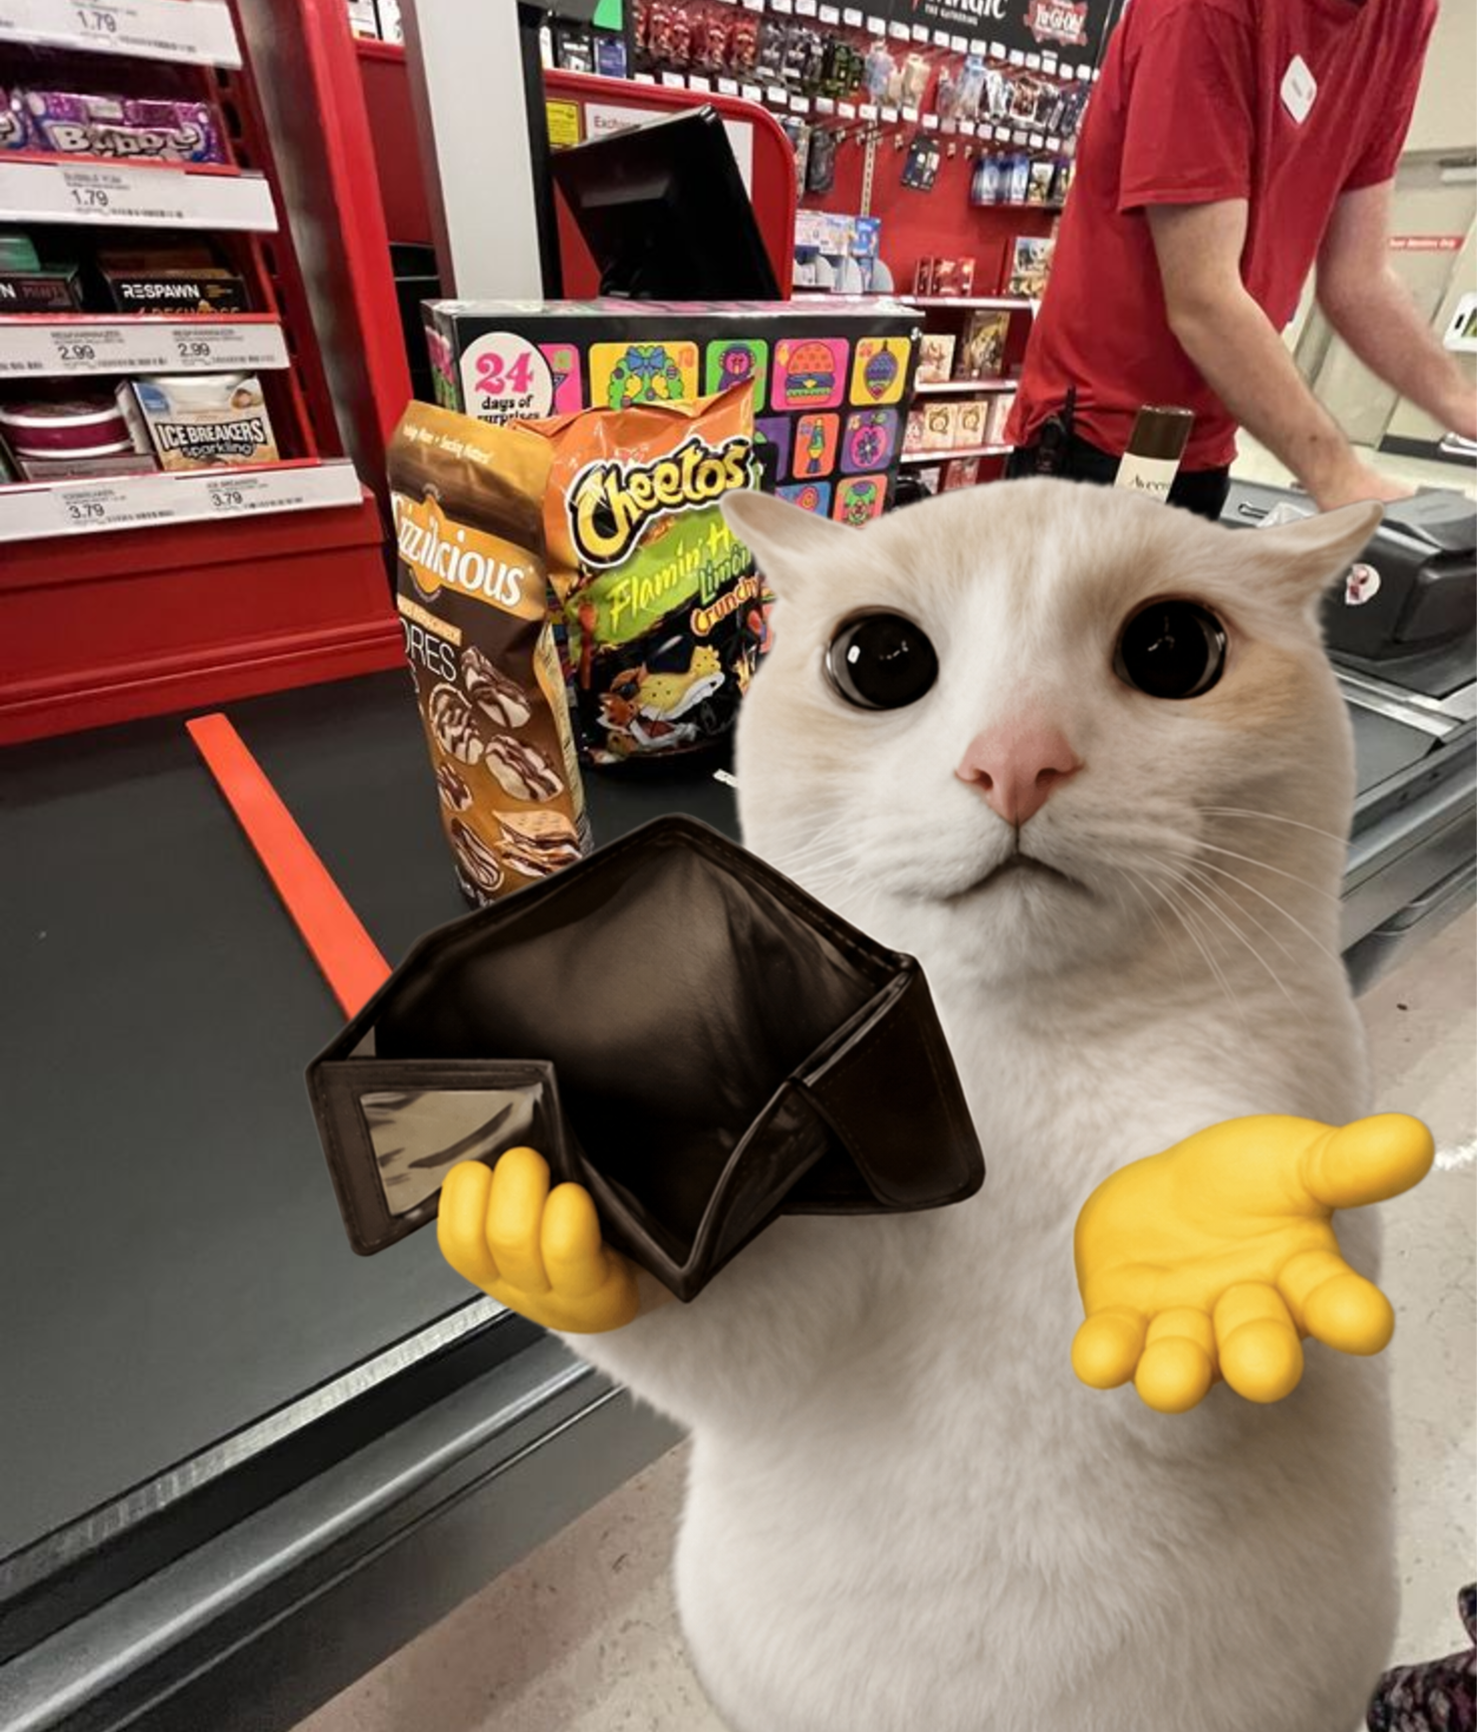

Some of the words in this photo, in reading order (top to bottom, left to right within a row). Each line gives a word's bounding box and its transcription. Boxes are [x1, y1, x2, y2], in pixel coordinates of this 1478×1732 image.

[77, 10, 117, 33] 1.79
[71, 189, 110, 207] 1.79
[121, 283, 201, 299] RESPAWN
[58, 344, 96, 361] 2.99
[178, 342, 212, 358] 2.99
[475, 351, 534, 395] 24
[481, 396, 516, 413] days
[517, 393, 535, 409] of
[157, 424, 188, 450] ICE
[187, 419, 265, 445] BREAKERS
[212, 490, 244, 507] 3.79
[570, 438, 752, 562] Cheetos
[69, 502, 106, 520] 3.79
[690, 572, 761, 637] Crunchy
